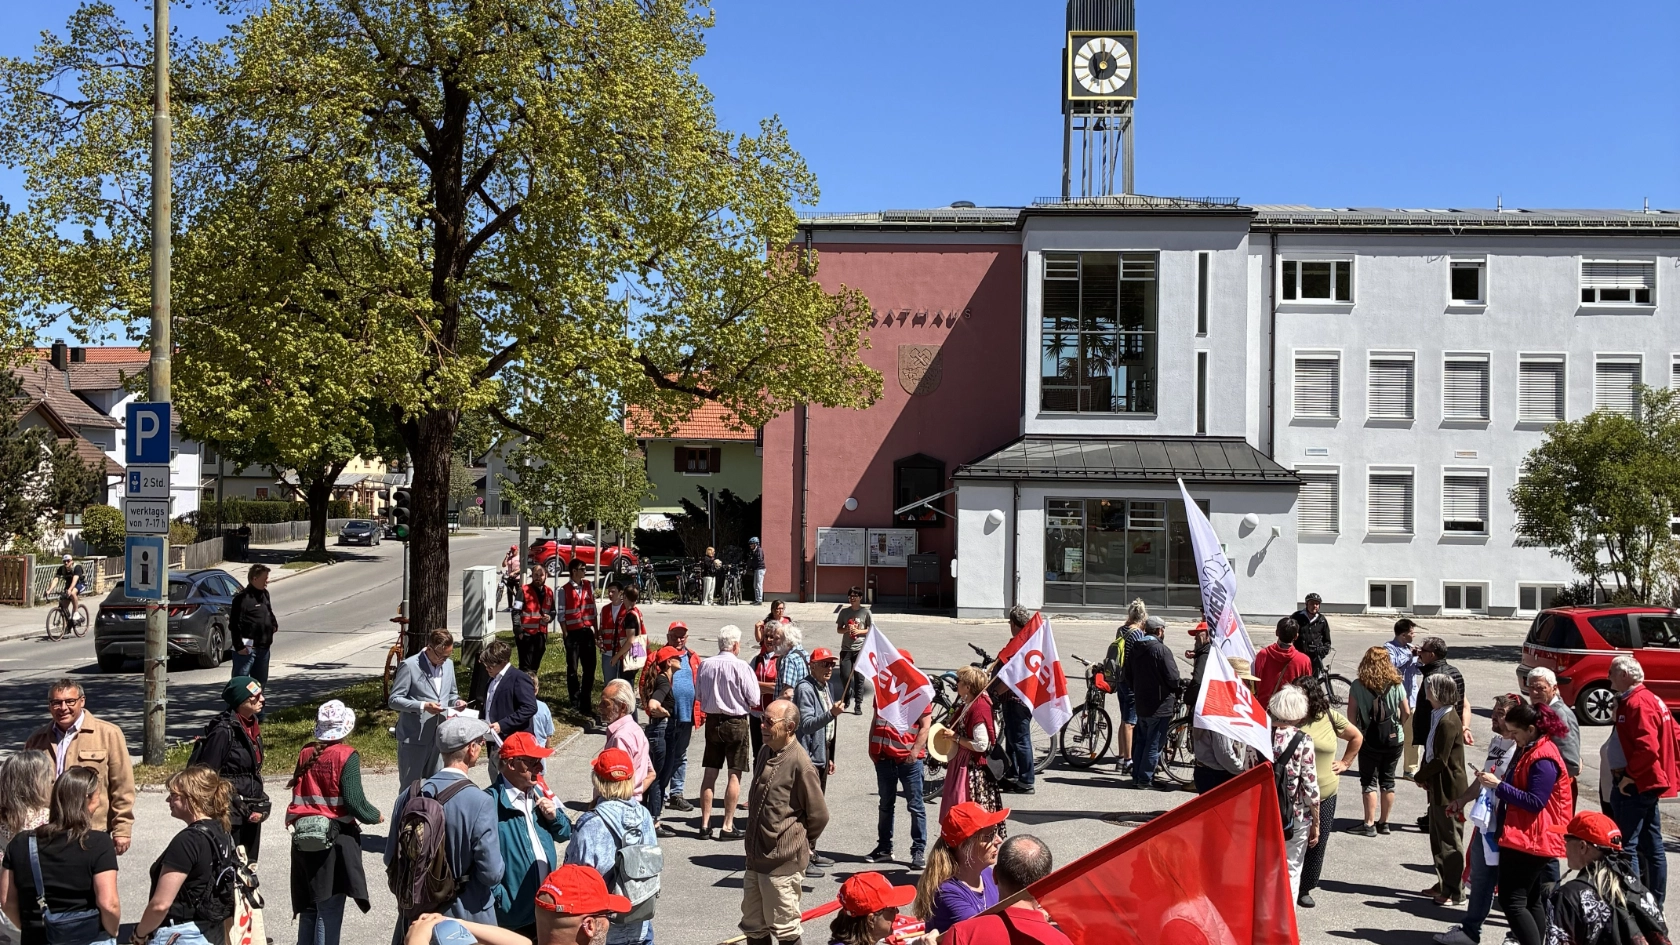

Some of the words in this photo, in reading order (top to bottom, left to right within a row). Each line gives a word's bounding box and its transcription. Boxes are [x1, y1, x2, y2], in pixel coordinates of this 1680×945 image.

[135, 411, 160, 456] P
[143, 477, 149, 488] 2
[150, 477, 166, 488] Std.
[130, 507, 165, 518] werktags
[129, 520, 142, 528] von
[145, 519, 160, 528] 7-17
[161, 519, 166, 528] h
